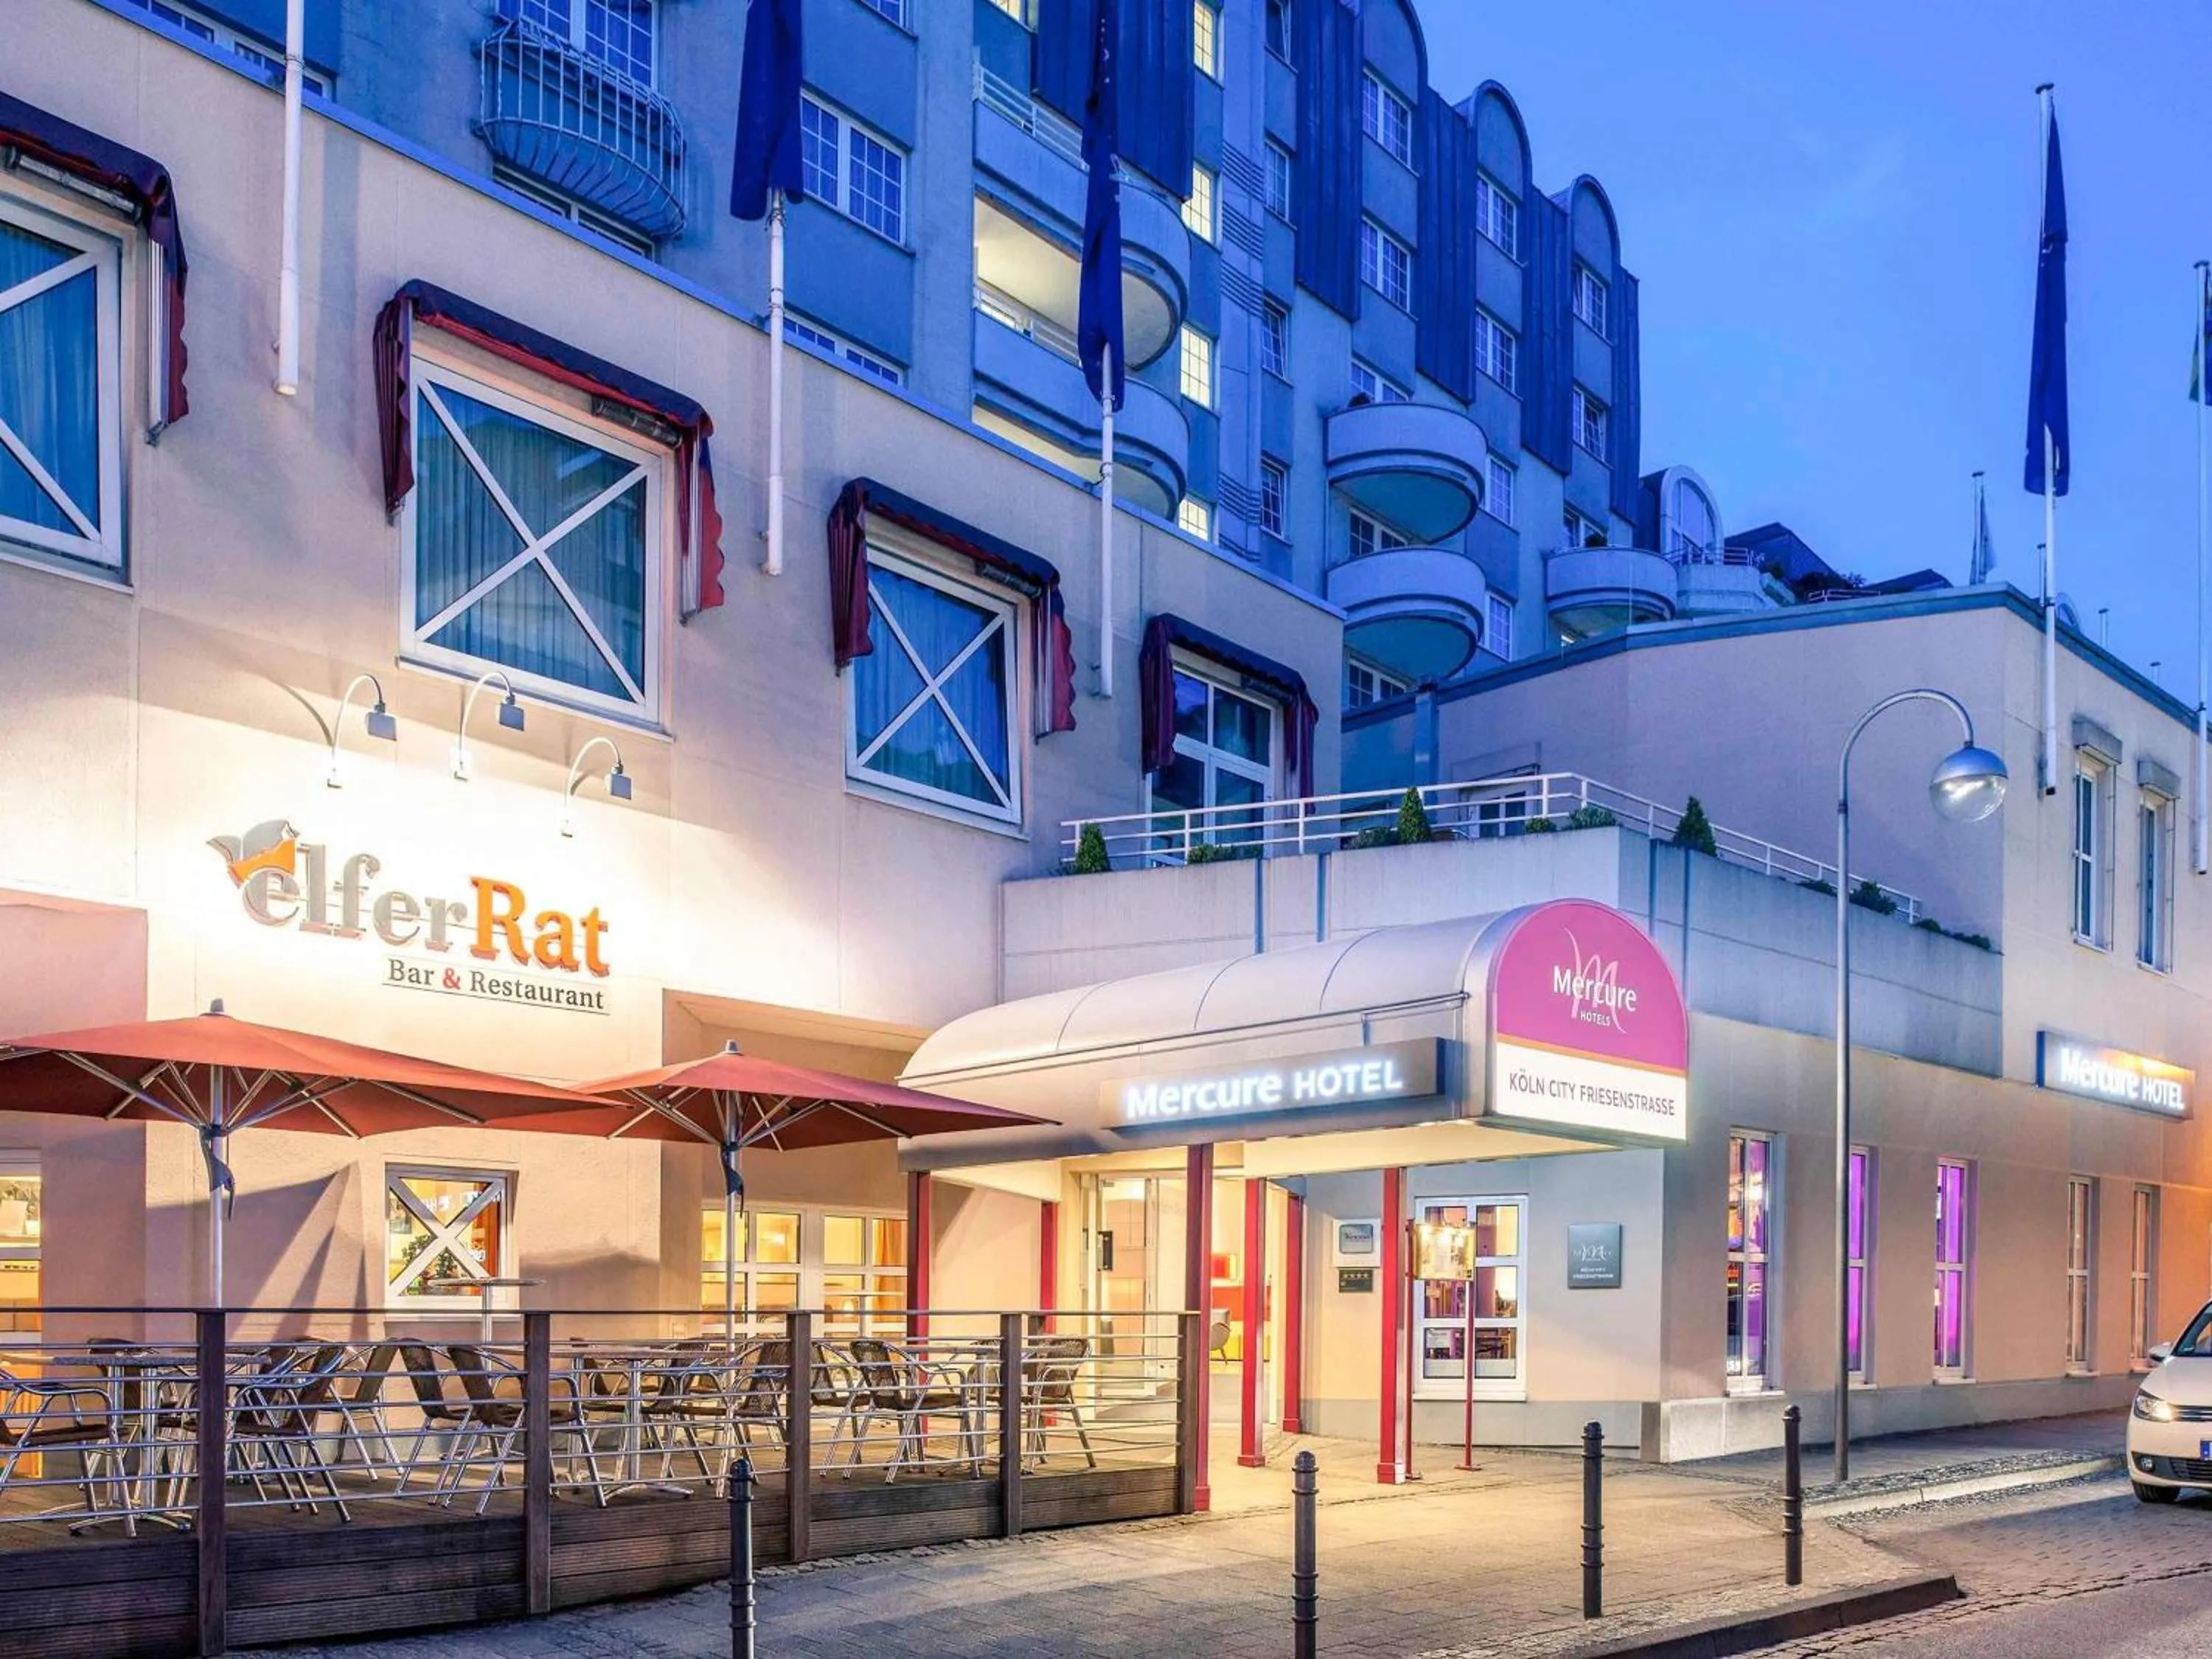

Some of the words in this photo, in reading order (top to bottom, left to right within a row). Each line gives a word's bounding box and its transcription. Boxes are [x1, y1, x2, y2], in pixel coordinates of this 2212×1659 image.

[242, 843, 610, 978] elferRat
[388, 958, 435, 986] Bar
[442, 967, 462, 990] &
[469, 970, 605, 1009] Restaurant
[1554, 964, 1637, 1012] Mercure
[1580, 1011, 1611, 1027] HOTELS
[1125, 1071, 1282, 1119] Mercure
[1293, 1059, 1404, 1099] HOTEL
[1509, 1068, 1545, 1096] KÖLN
[1548, 1079, 1576, 1100] CITY
[1580, 1085, 1675, 1116] FRIESENSTRASSE
[2059, 1047, 2139, 1099] Mercure
[2142, 1076, 2186, 1110] HOTEL
